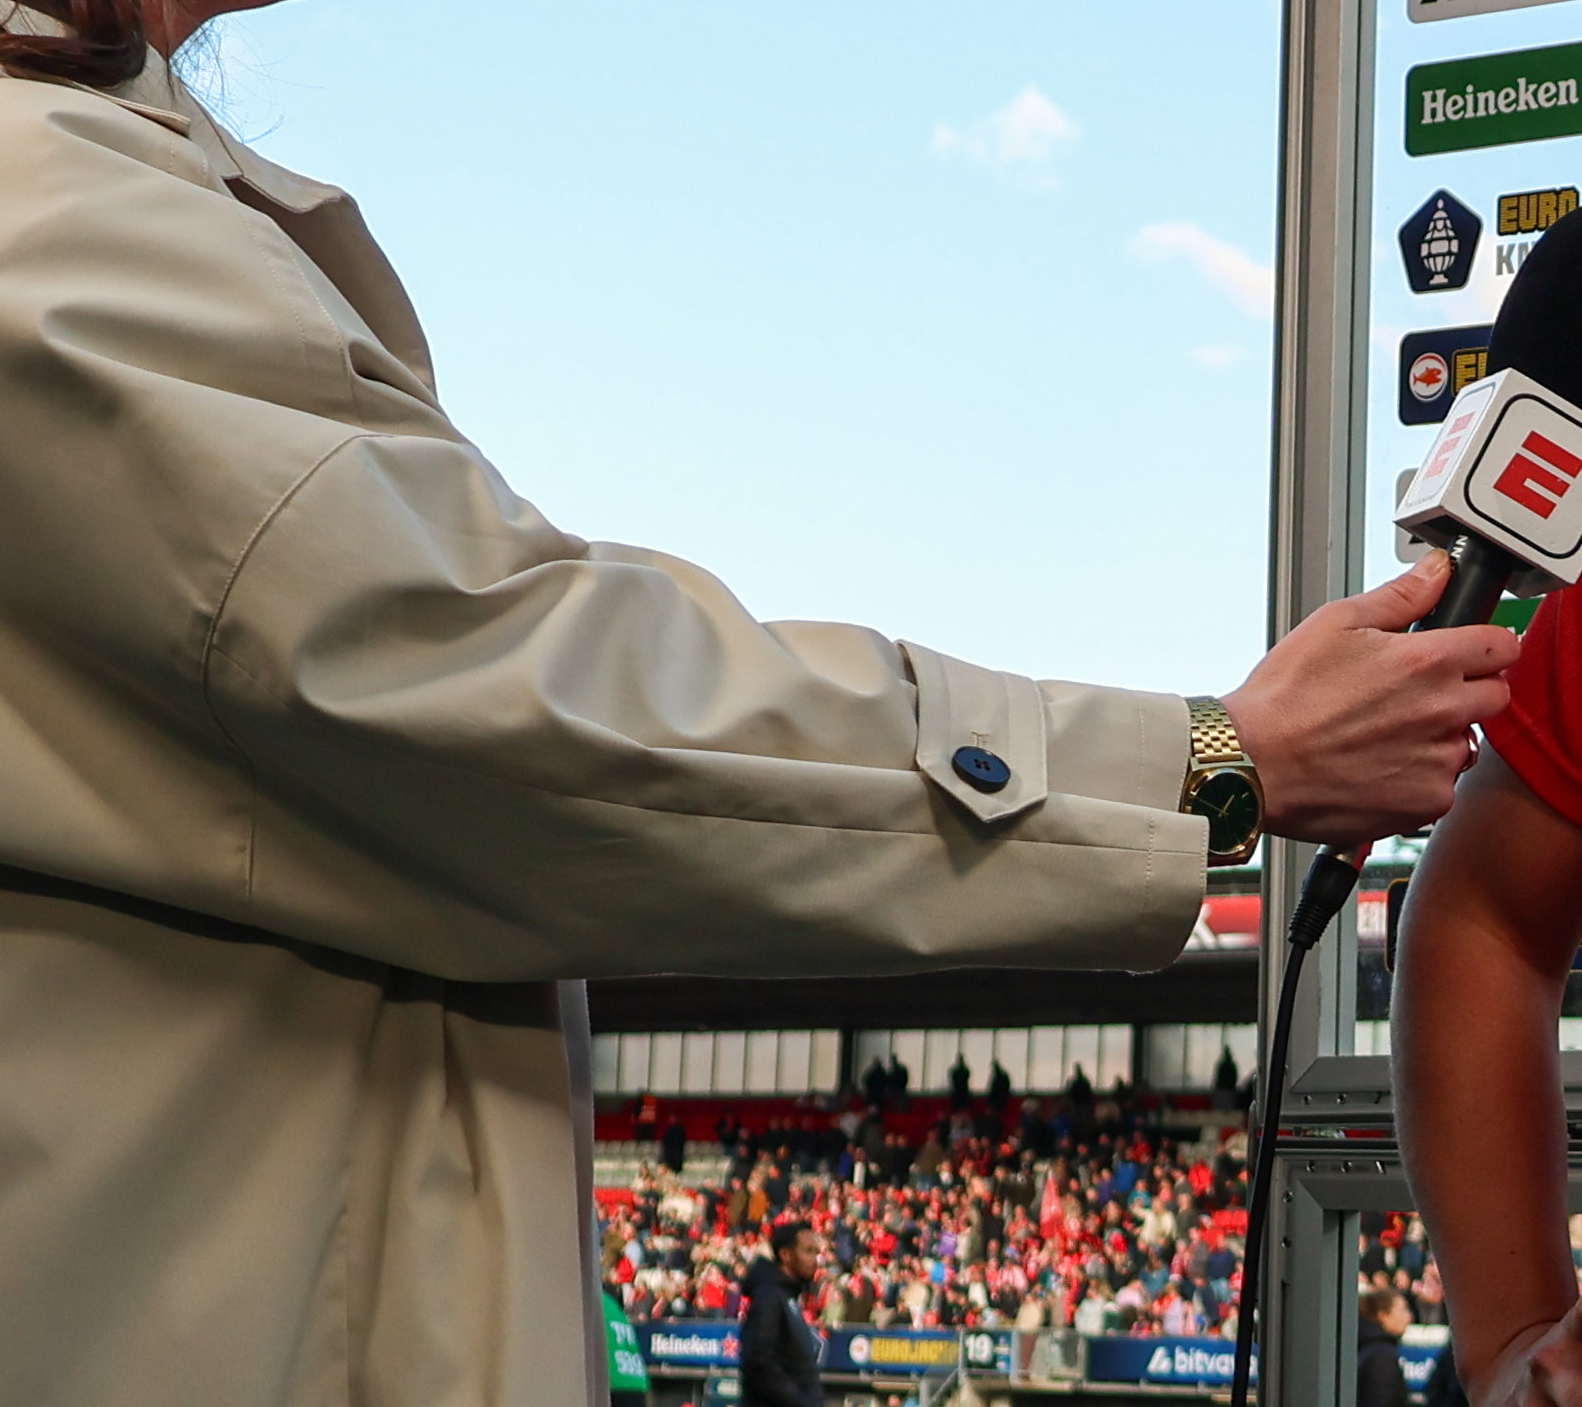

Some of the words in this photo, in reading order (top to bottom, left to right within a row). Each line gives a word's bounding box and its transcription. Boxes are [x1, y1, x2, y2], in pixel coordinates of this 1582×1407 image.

[1420, 76, 1579, 125] Heineken
[650, 1332, 718, 1356] Heineken
[965, 1334, 994, 1363] 19
